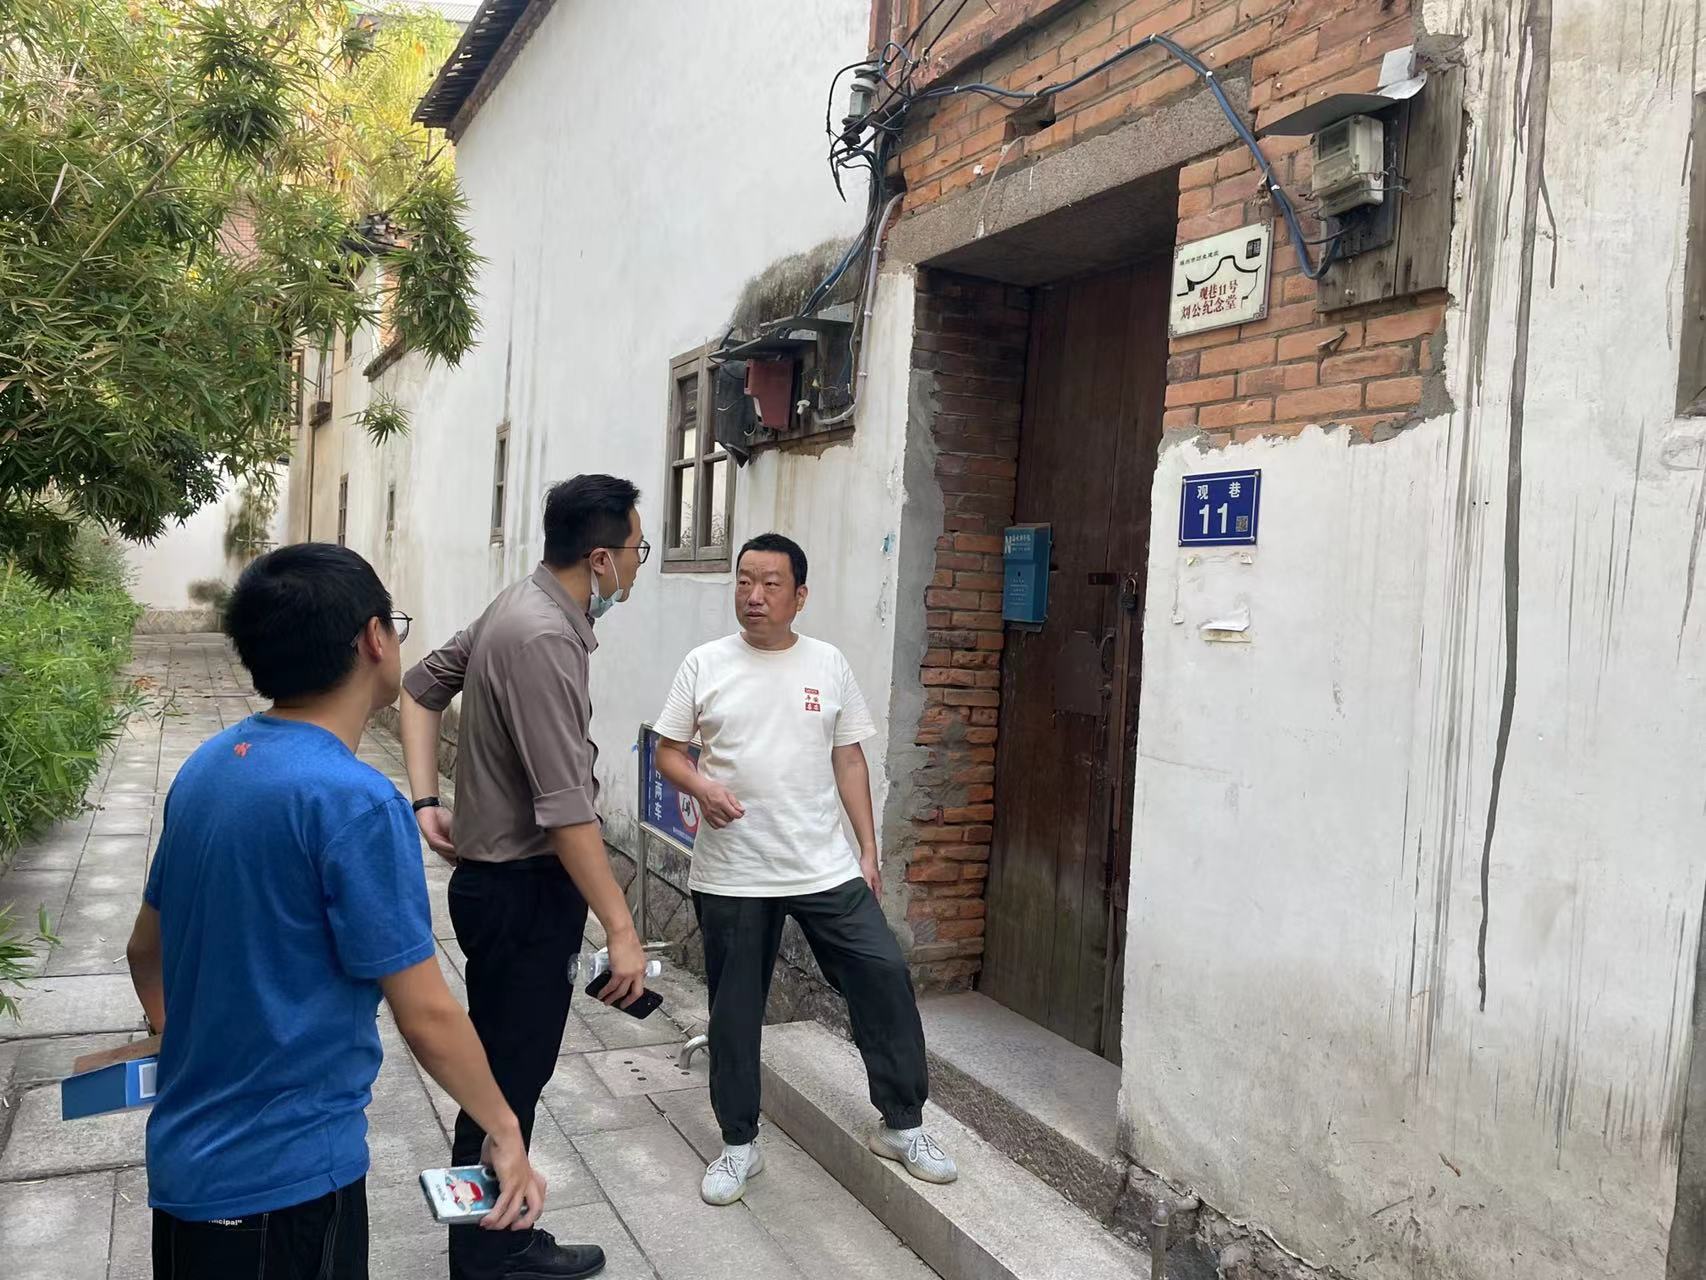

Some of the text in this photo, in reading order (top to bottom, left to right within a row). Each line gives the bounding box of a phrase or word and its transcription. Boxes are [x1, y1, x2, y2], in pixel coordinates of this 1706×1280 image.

[1180, 294, 1237, 320] 刘公纪念堂
[1197, 482, 1241, 500] 观巷
[1199, 503, 1228, 534] 11
